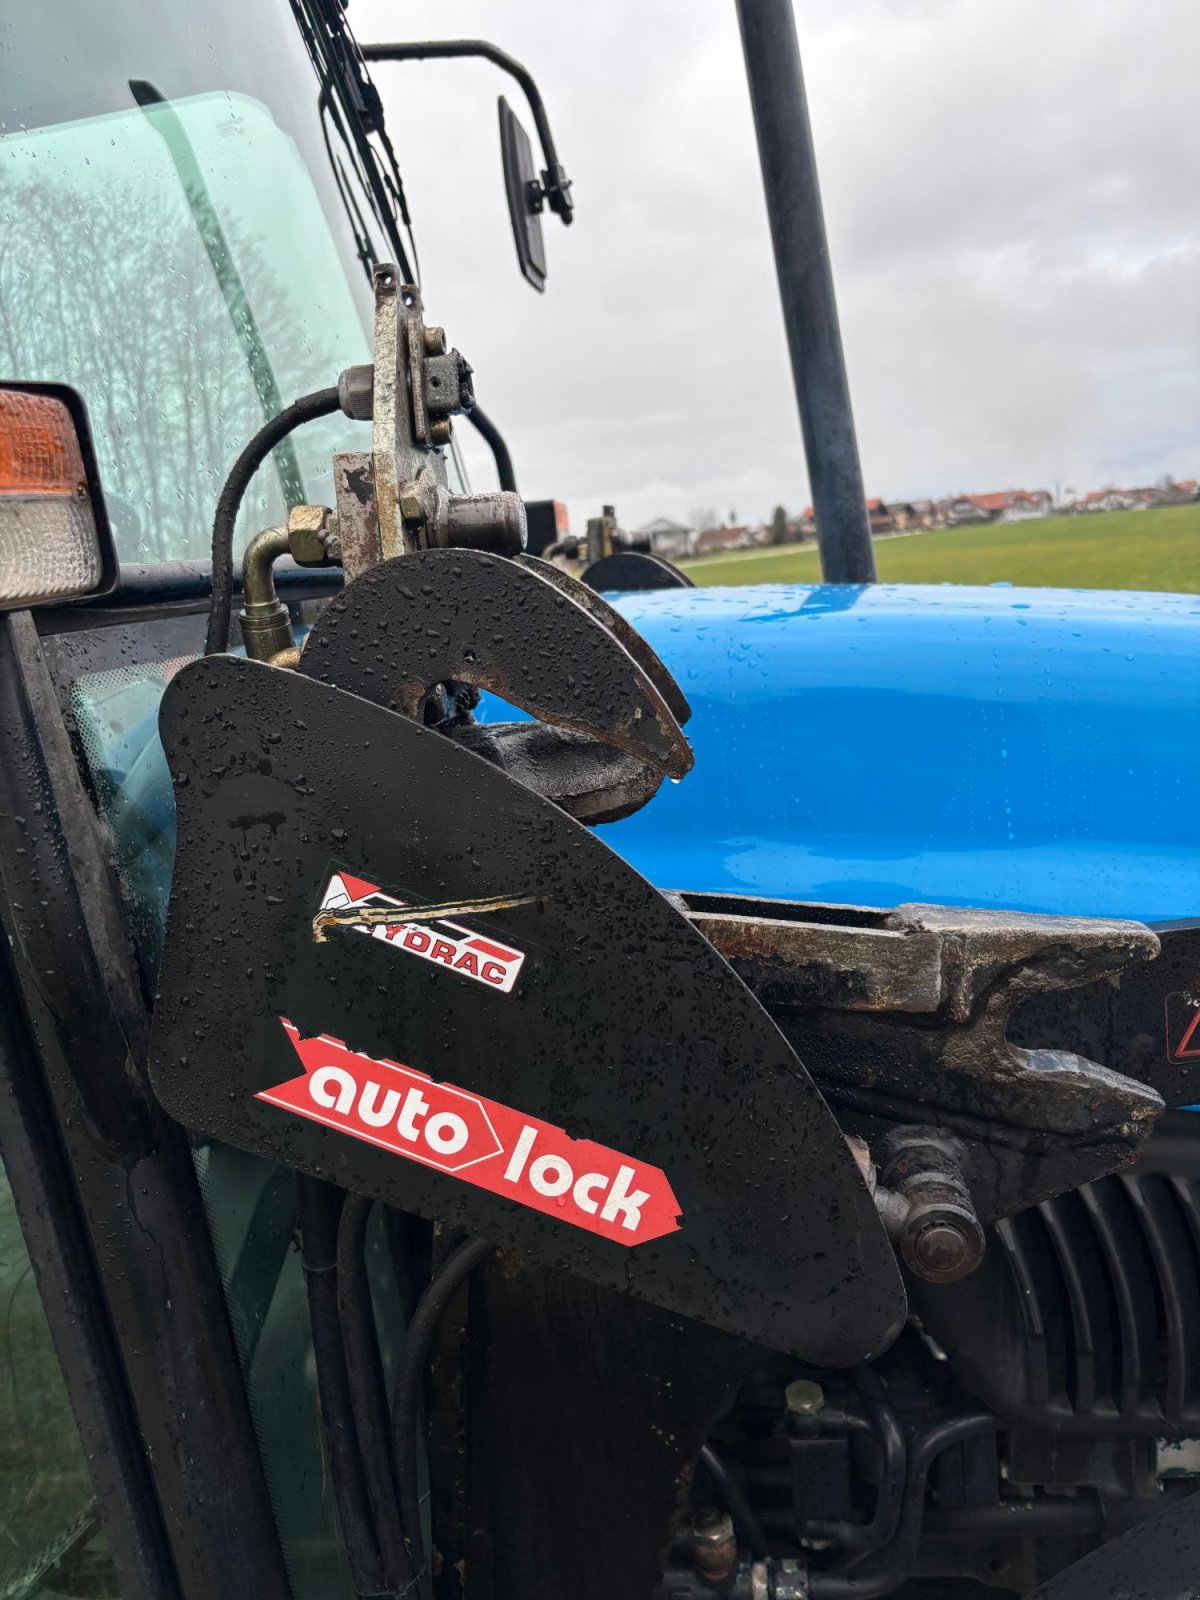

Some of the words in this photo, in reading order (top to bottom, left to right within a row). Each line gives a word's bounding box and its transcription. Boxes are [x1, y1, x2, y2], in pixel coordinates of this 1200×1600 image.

[367, 922, 508, 985] YDRAC
[309, 1066, 469, 1155] auto
[504, 1125, 651, 1231] lock
